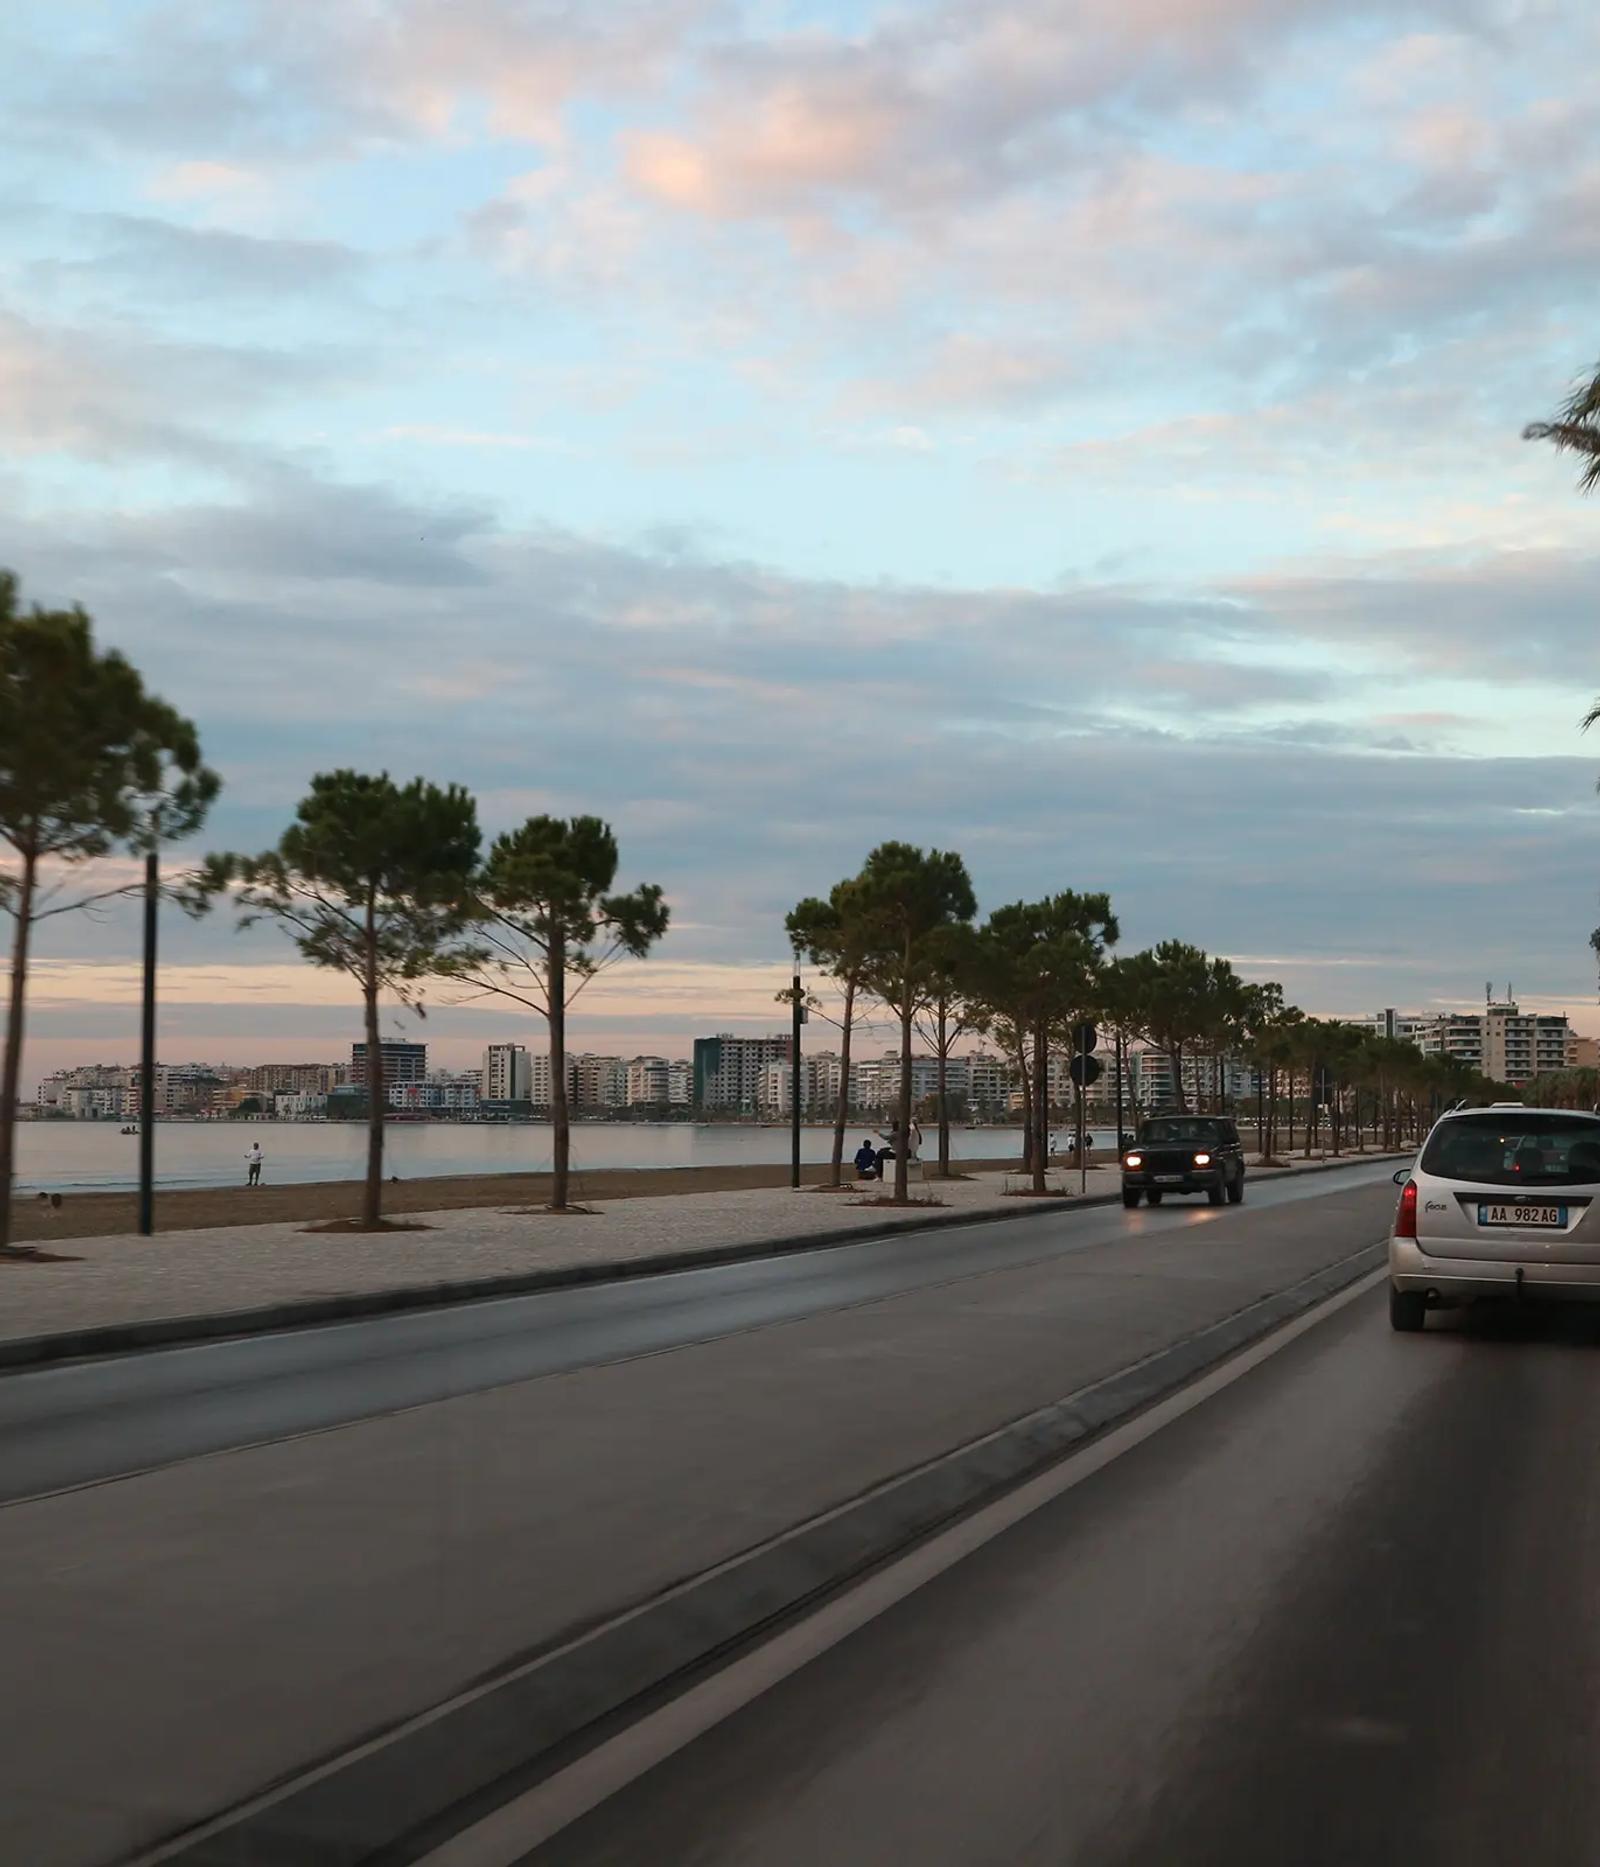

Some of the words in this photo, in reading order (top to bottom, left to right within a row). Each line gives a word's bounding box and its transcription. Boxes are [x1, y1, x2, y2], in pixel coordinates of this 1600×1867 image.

[1491, 1207, 1507, 1221] AA
[1514, 1208, 1539, 1222] 982
[1541, 1209, 1557, 1223] AG
